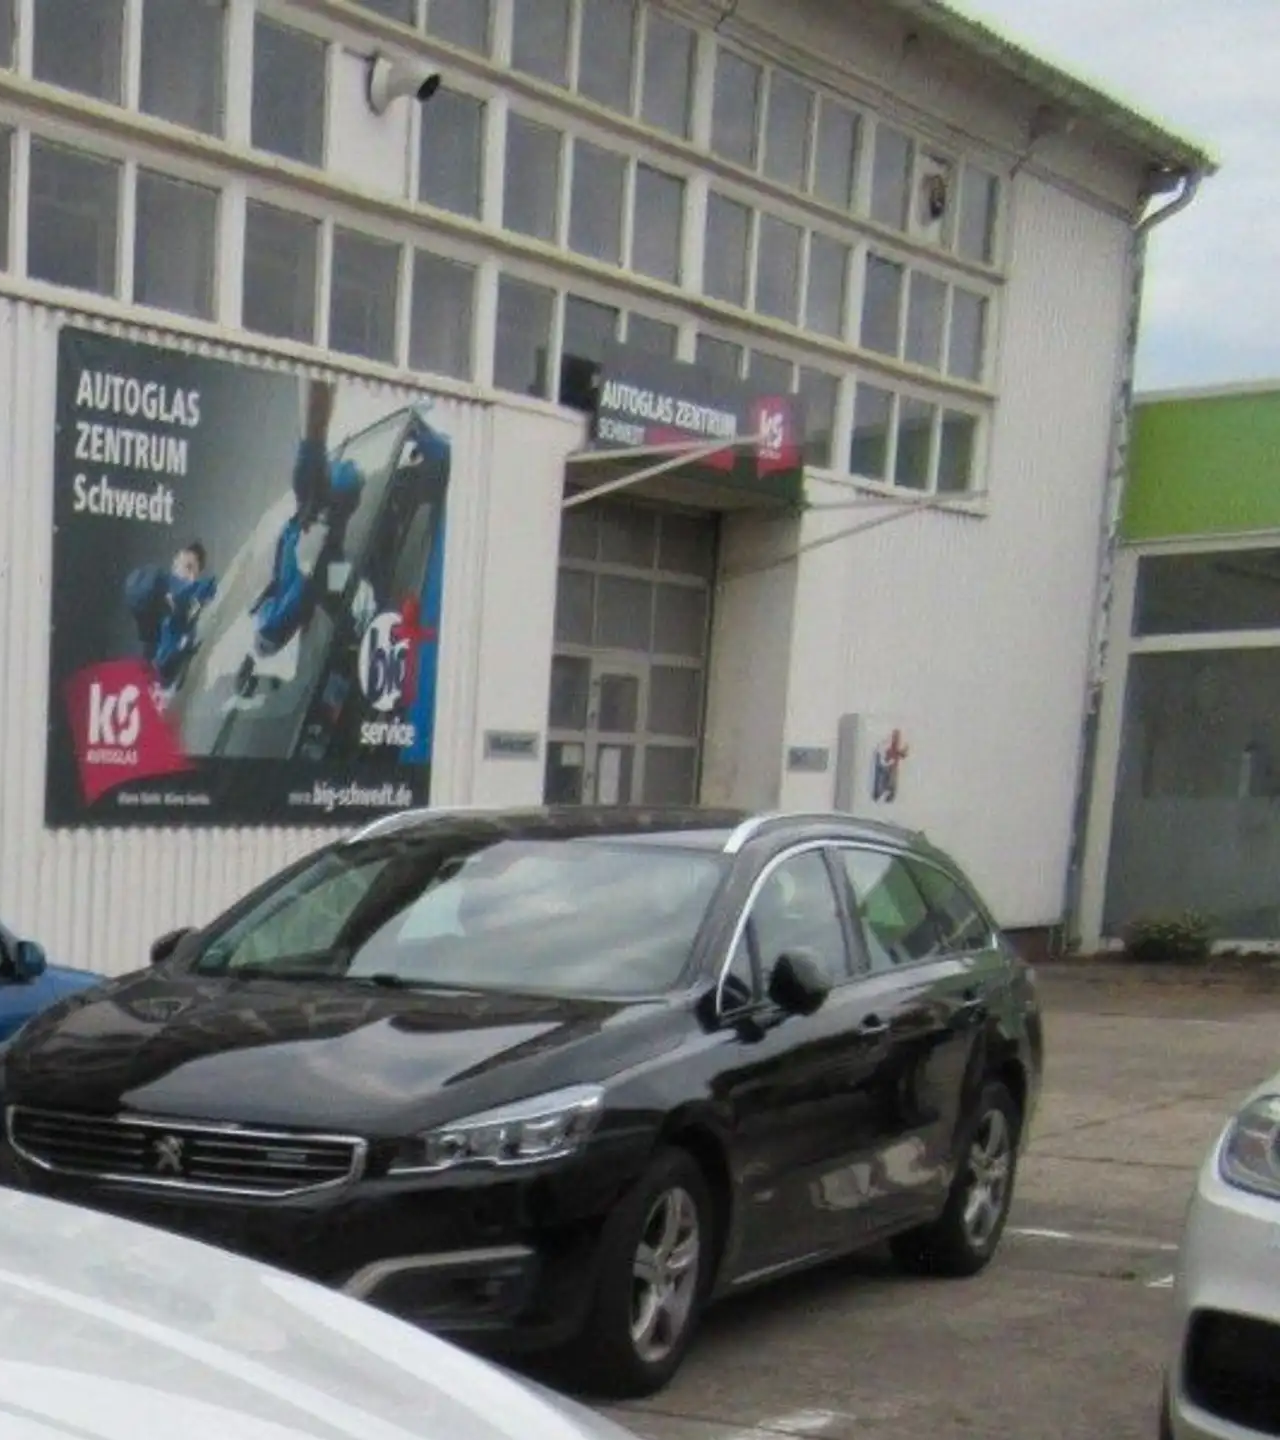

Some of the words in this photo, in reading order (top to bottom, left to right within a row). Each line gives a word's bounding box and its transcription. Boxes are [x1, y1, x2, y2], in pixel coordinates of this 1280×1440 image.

[75, 368, 201, 429] AUTOGLAS
[600, 379, 674, 424] AUTOGLAS
[74, 420, 188, 477] ZENTRUM
[72, 472, 175, 525] Schwedt
[360, 716, 415, 746] service
